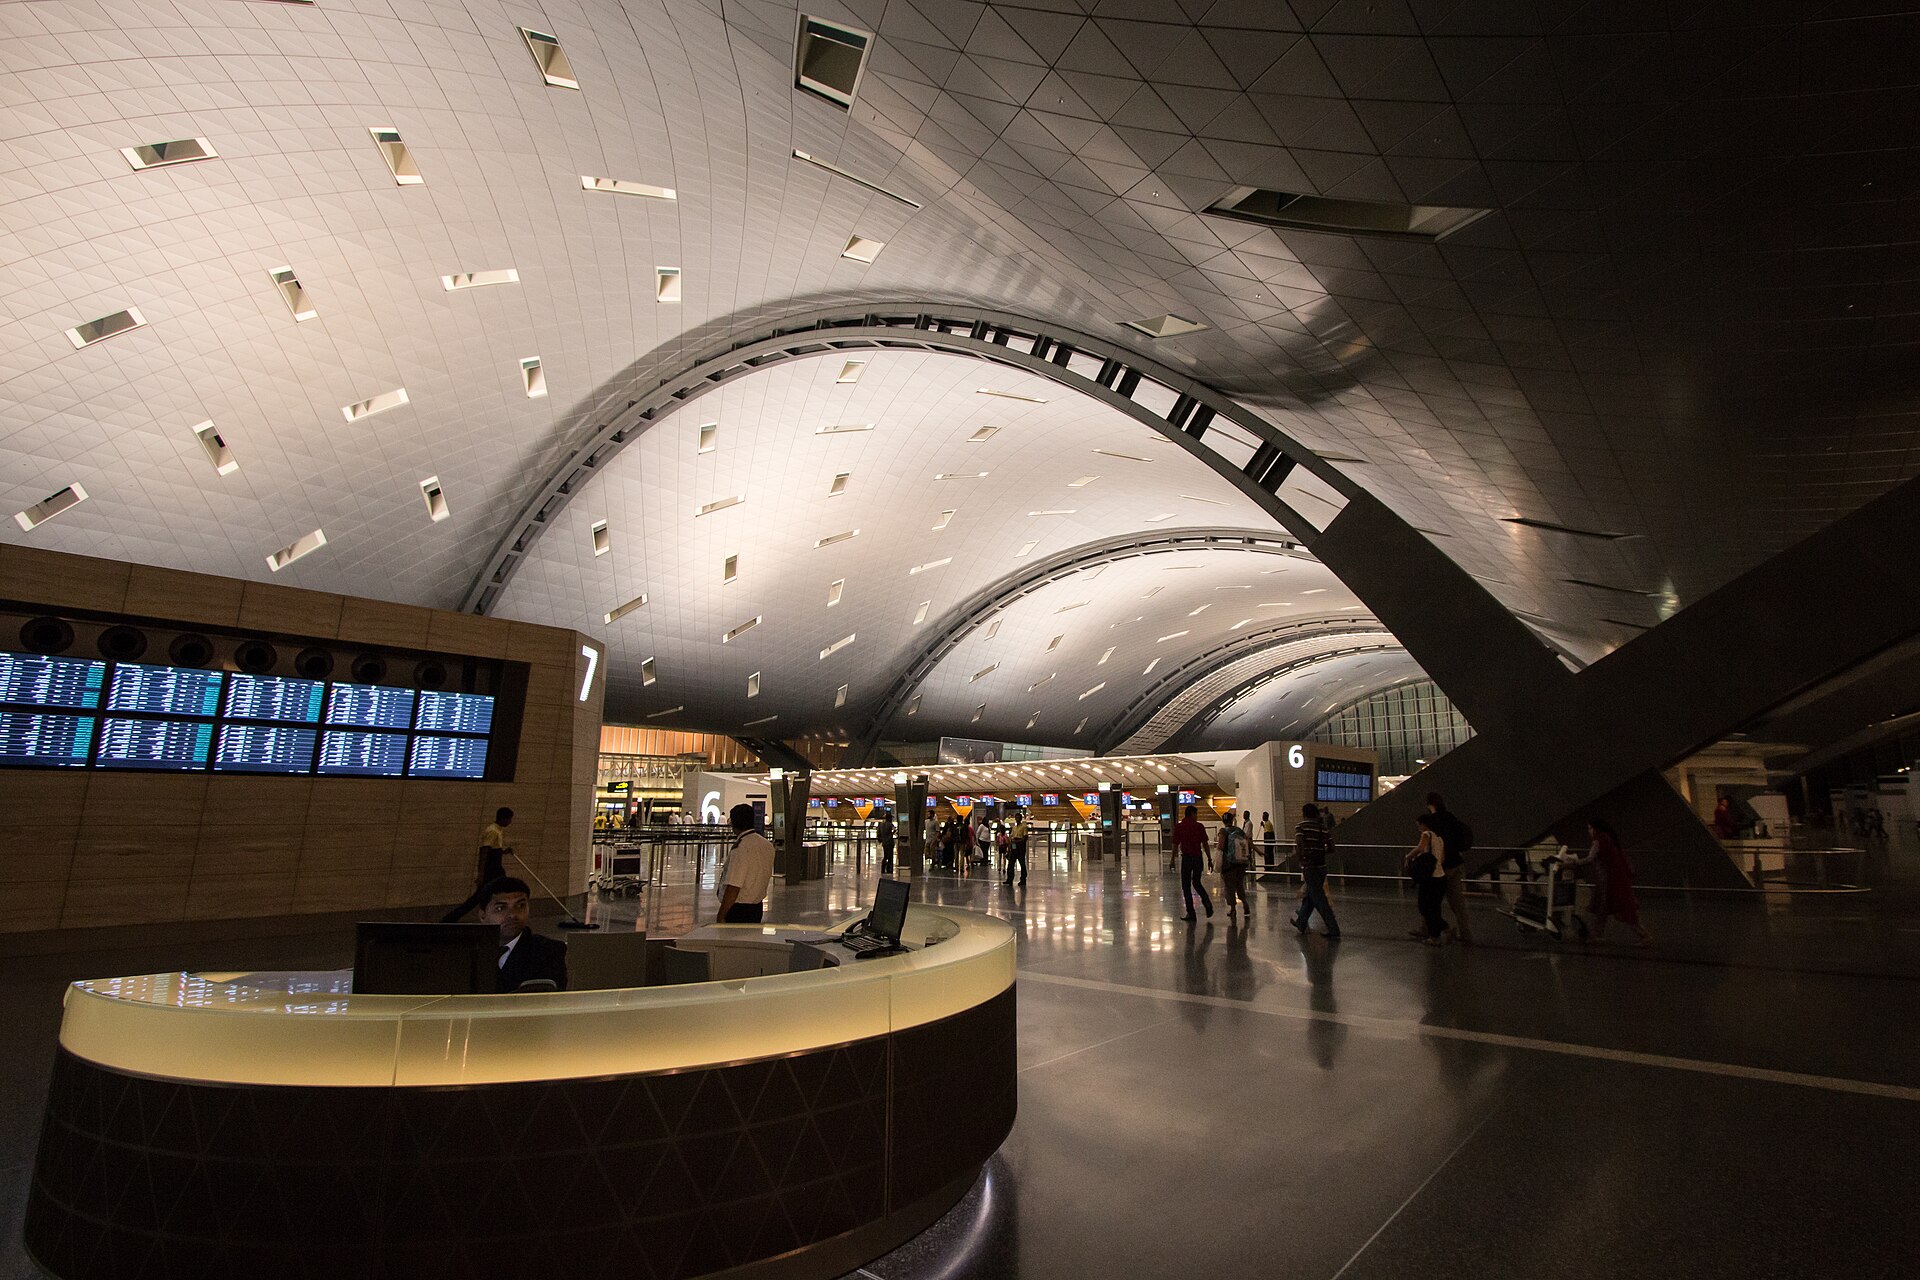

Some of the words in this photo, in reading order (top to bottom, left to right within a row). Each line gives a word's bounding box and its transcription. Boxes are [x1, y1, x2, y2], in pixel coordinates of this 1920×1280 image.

[580, 645, 598, 701] 7
[1289, 745, 1304, 768] 6
[701, 791, 720, 825] 6
